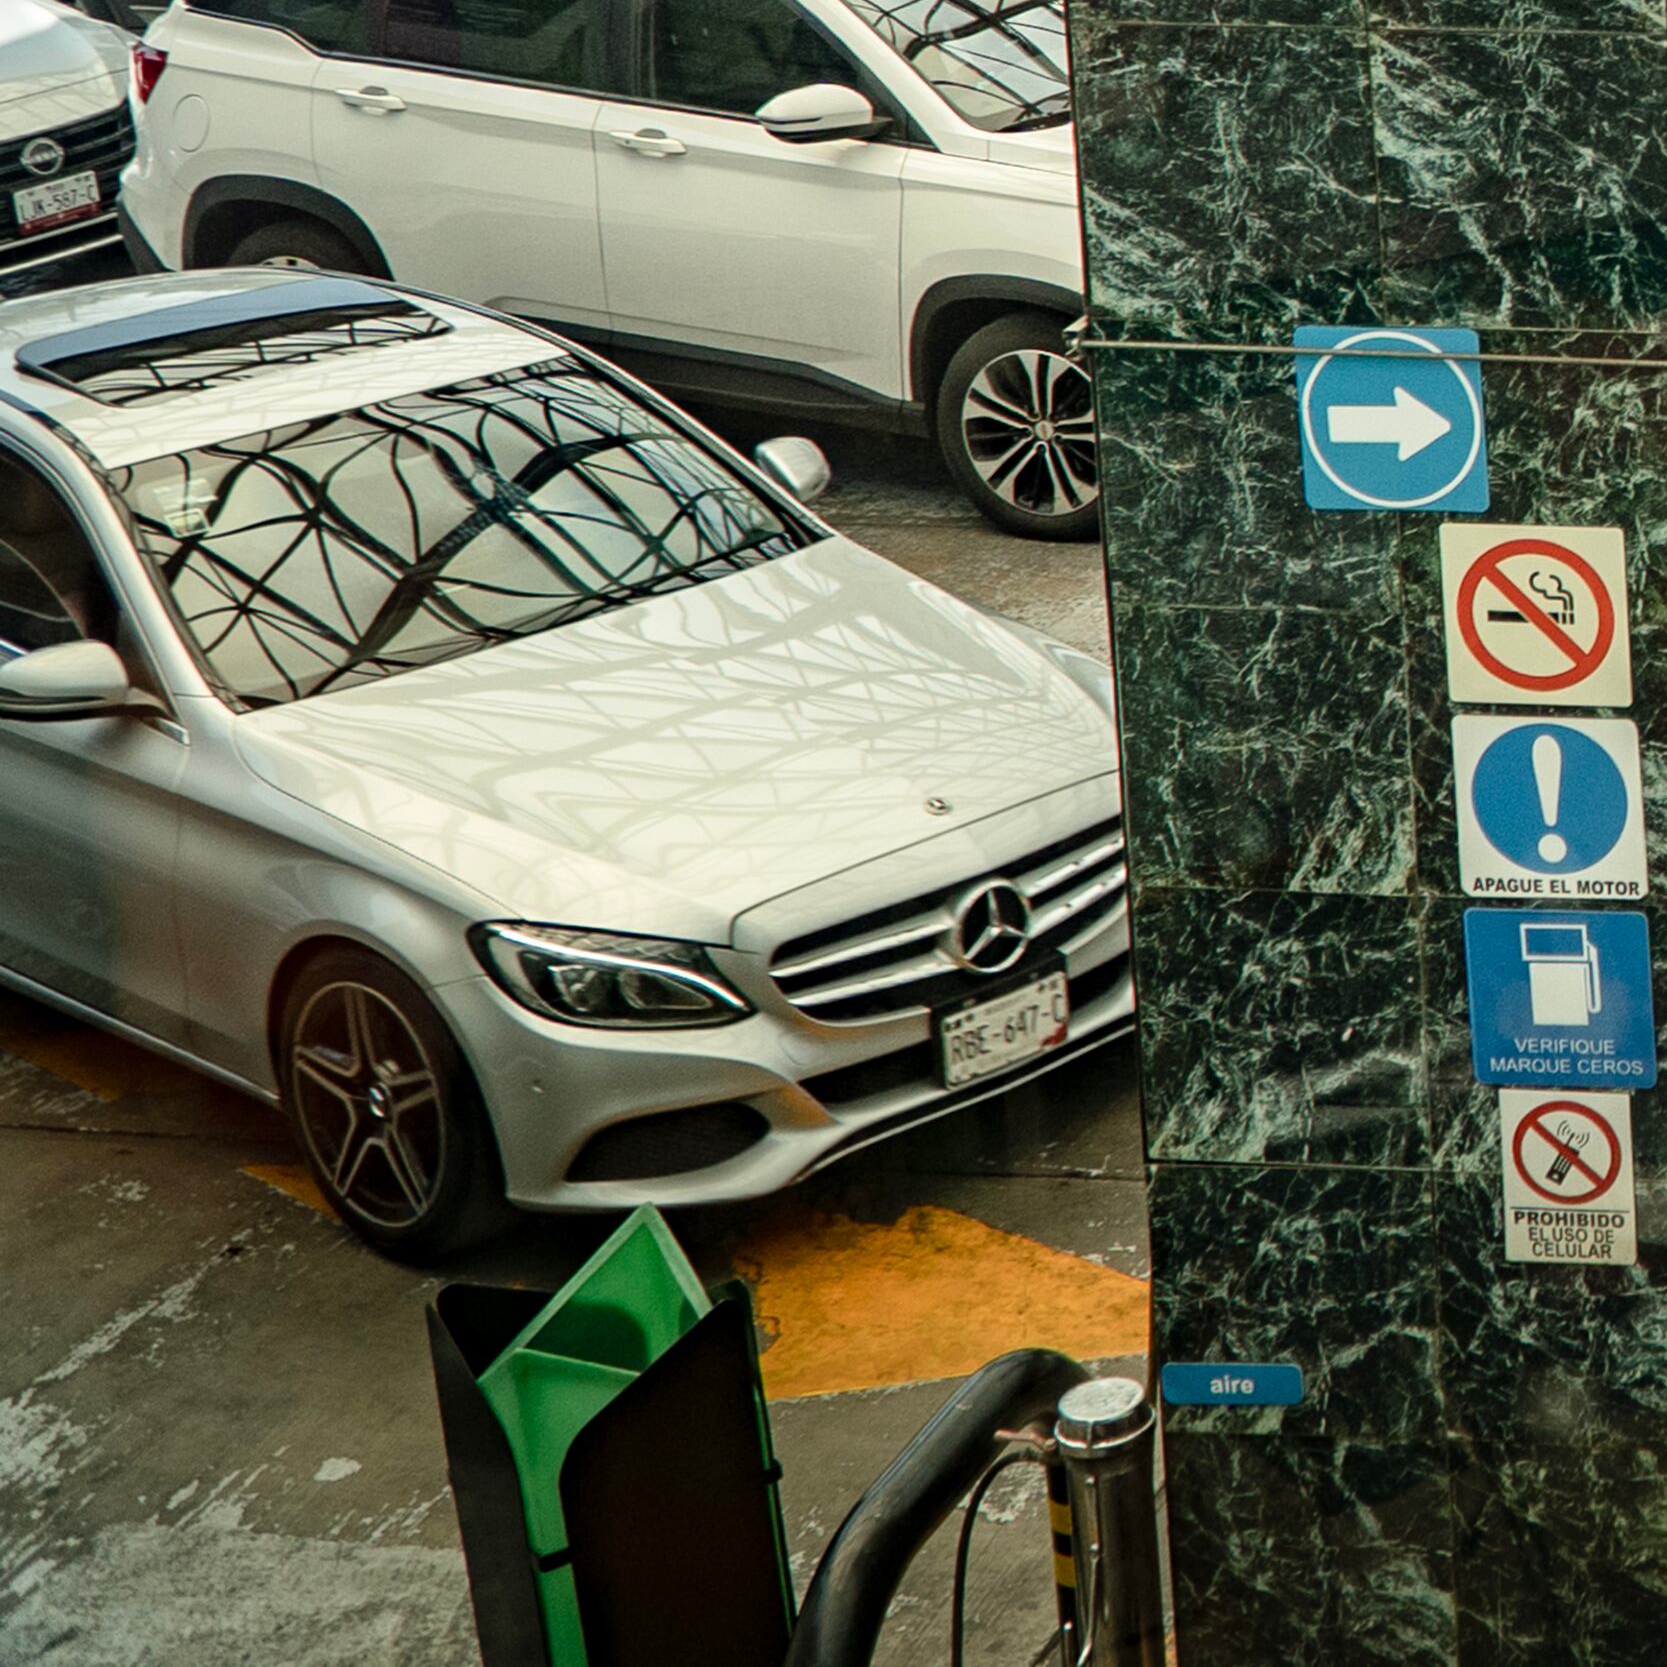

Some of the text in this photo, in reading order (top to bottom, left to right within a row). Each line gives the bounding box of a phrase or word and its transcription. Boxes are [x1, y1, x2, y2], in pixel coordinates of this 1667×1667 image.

[1473, 877, 1640, 896] APAGUE EL MOTOR
[1514, 1038, 1616, 1055] VERIFIQUE
[1490, 1056, 1644, 1076] MARQUE CEROS
[1514, 1211, 1625, 1229] PROHIBIDO
[1528, 1227, 1614, 1245] EL USO DE
[1532, 1241, 1612, 1259] CELULAR
[1209, 1373, 1255, 1396] aire
